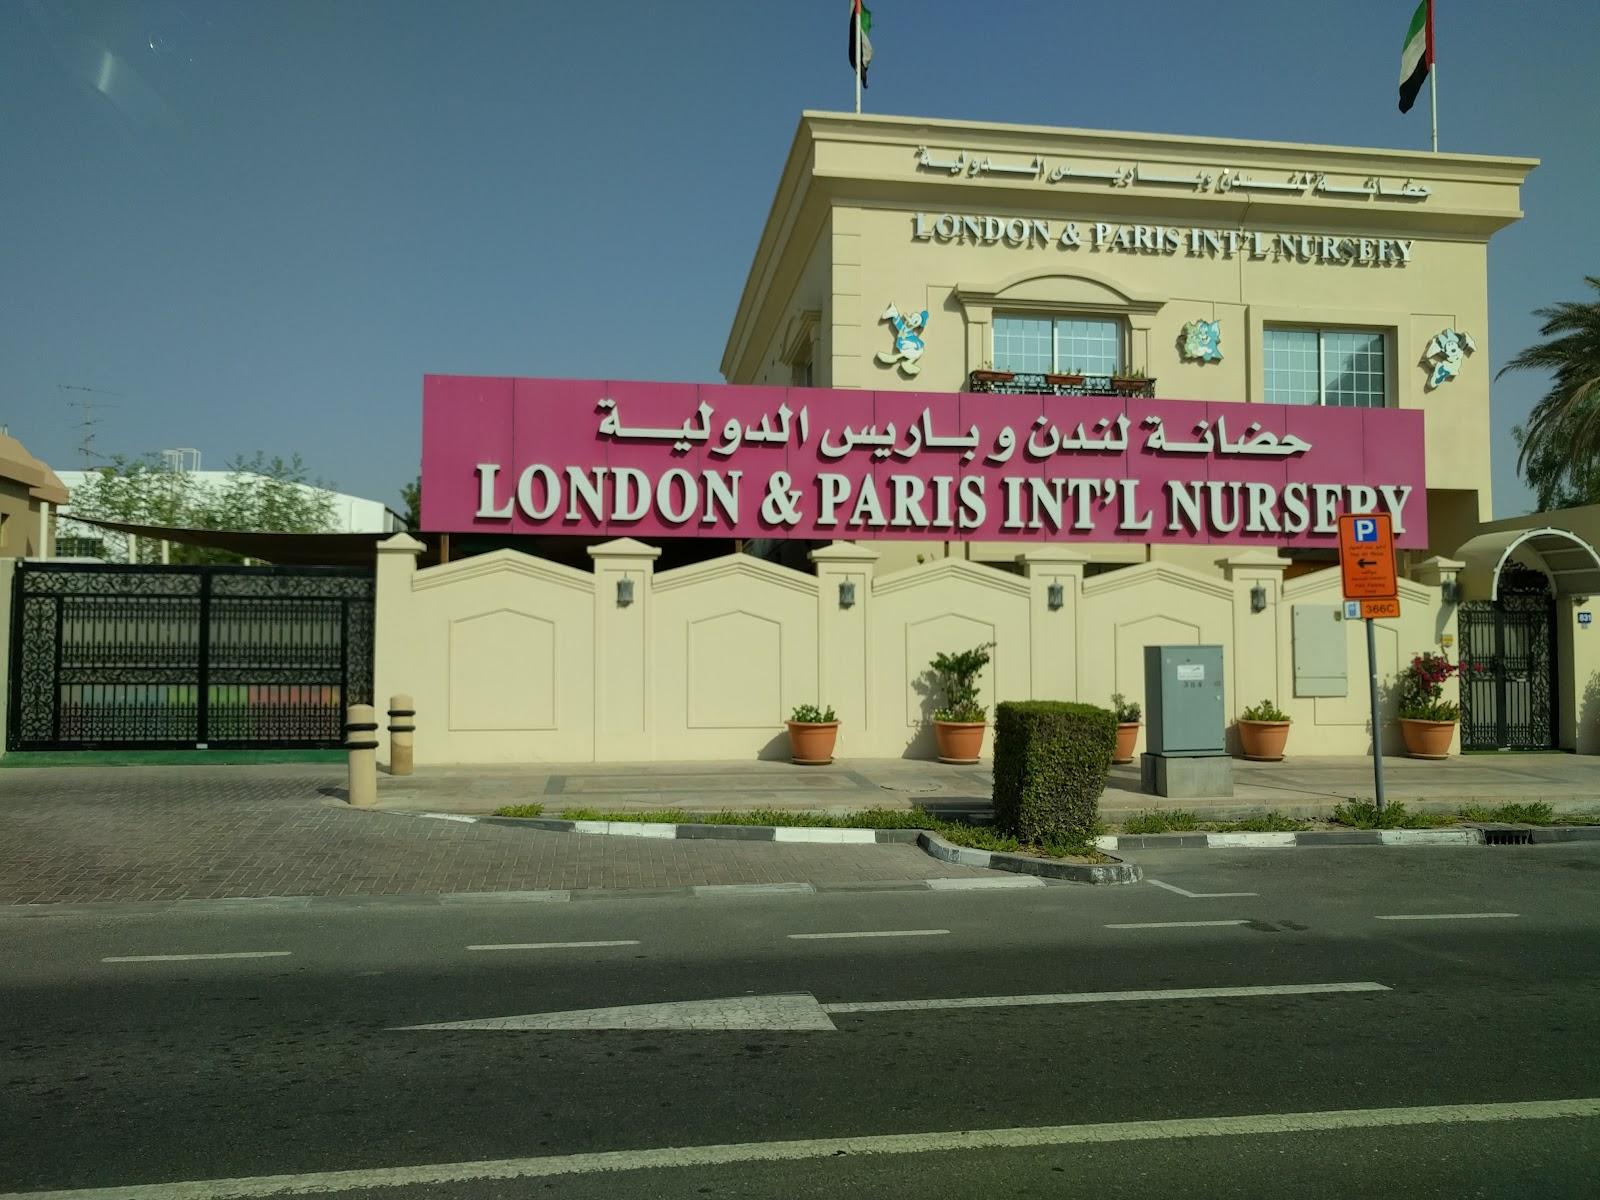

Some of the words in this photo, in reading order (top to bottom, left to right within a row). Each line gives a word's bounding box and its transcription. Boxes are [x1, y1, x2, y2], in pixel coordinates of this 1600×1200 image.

[914, 212, 1049, 245] LONDON
[1061, 222, 1081, 246] &
[1095, 222, 1181, 250] PARIS
[1190, 227, 1272, 257] INT'L
[1279, 234, 1415, 263] NURSERY
[598, 398, 810, 456] الدولية
[1027, 412, 1132, 458] لندن
[1146, 415, 1313, 455] حضانة
[475, 463, 743, 526] LONDON
[760, 470, 804, 526] &
[816, 472, 988, 530] PARIS
[1002, 476, 1153, 531] INT'L
[1168, 480, 1413, 535] NURSERY
[1356, 519, 1375, 542] P
